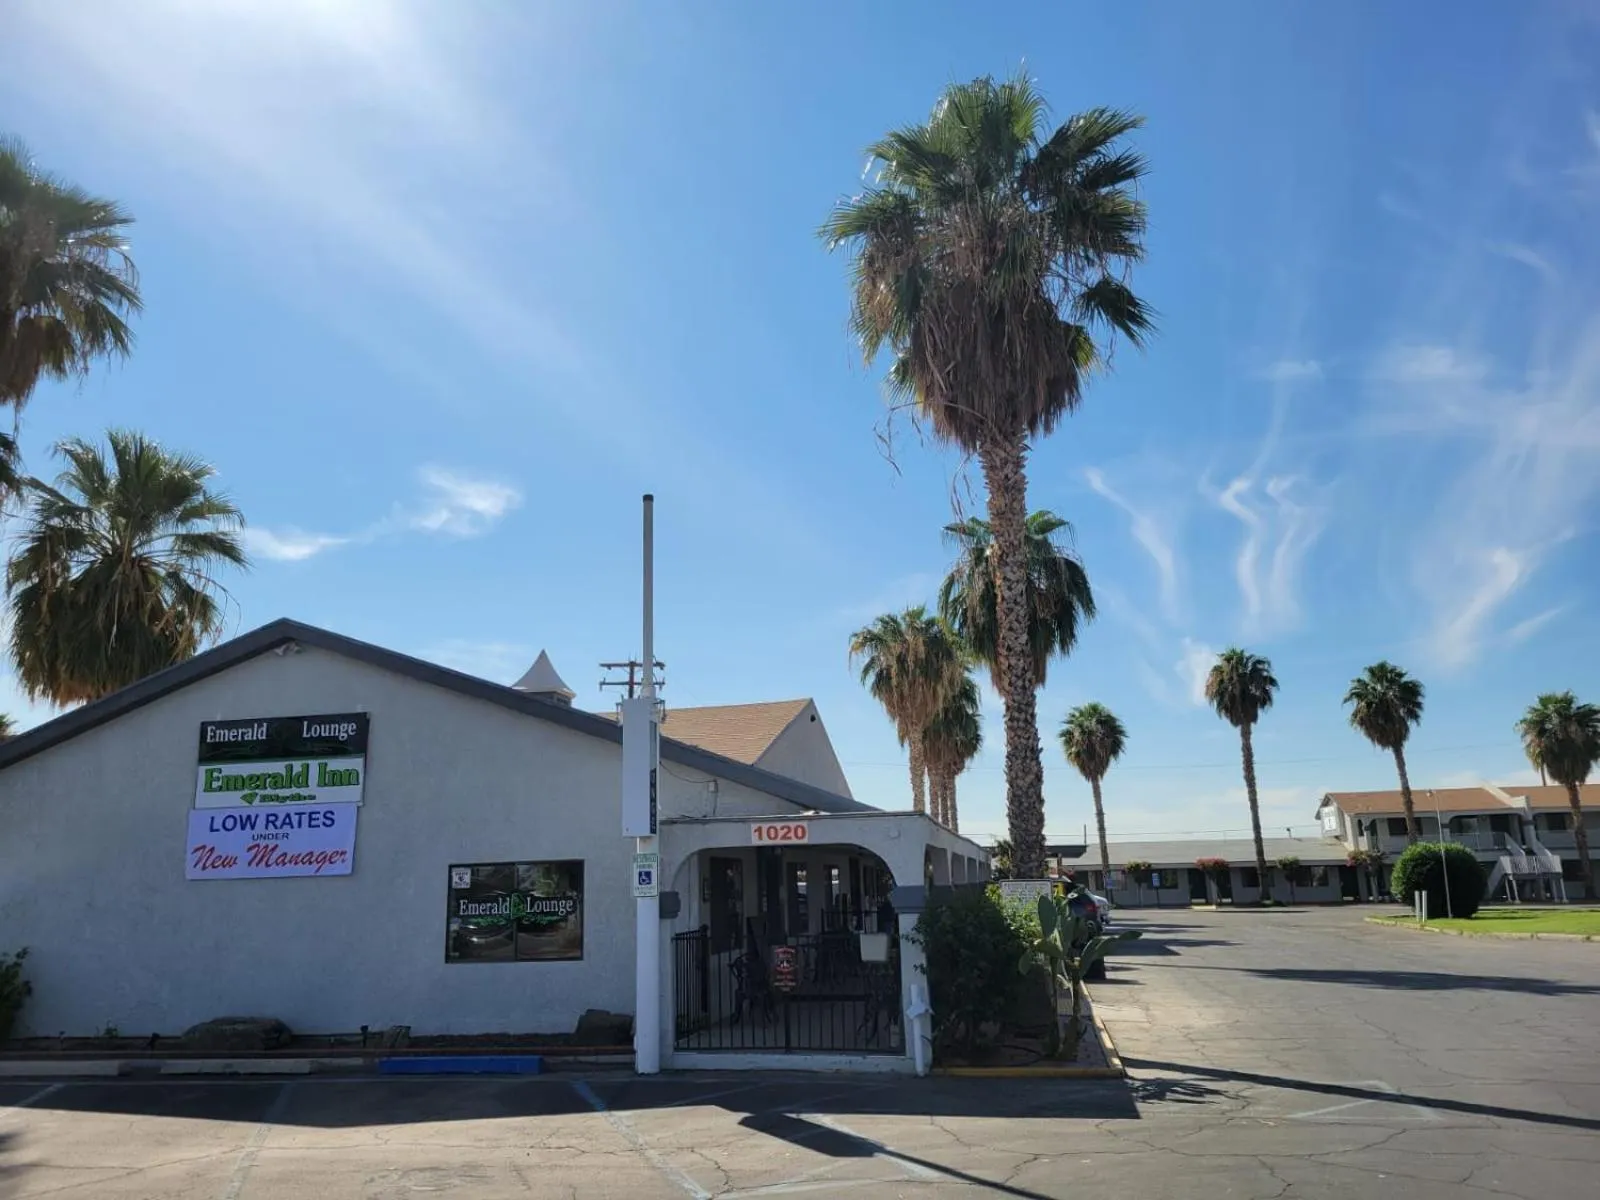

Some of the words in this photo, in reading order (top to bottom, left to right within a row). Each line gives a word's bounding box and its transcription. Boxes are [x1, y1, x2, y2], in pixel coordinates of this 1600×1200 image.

[206, 722, 268, 743] Emerald
[302, 720, 357, 741] Lounge
[203, 762, 310, 793] Emerald
[317, 761, 360, 788] Inn
[209, 813, 259, 833] LOW
[265, 810, 336, 830] RATES
[753, 824, 807, 841] 1020
[252, 832, 290, 842] UNDER
[191, 844, 239, 871] New
[246, 843, 348, 874] Manager
[460, 897, 510, 915] Emerald
[526, 897, 573, 916] Lounge
